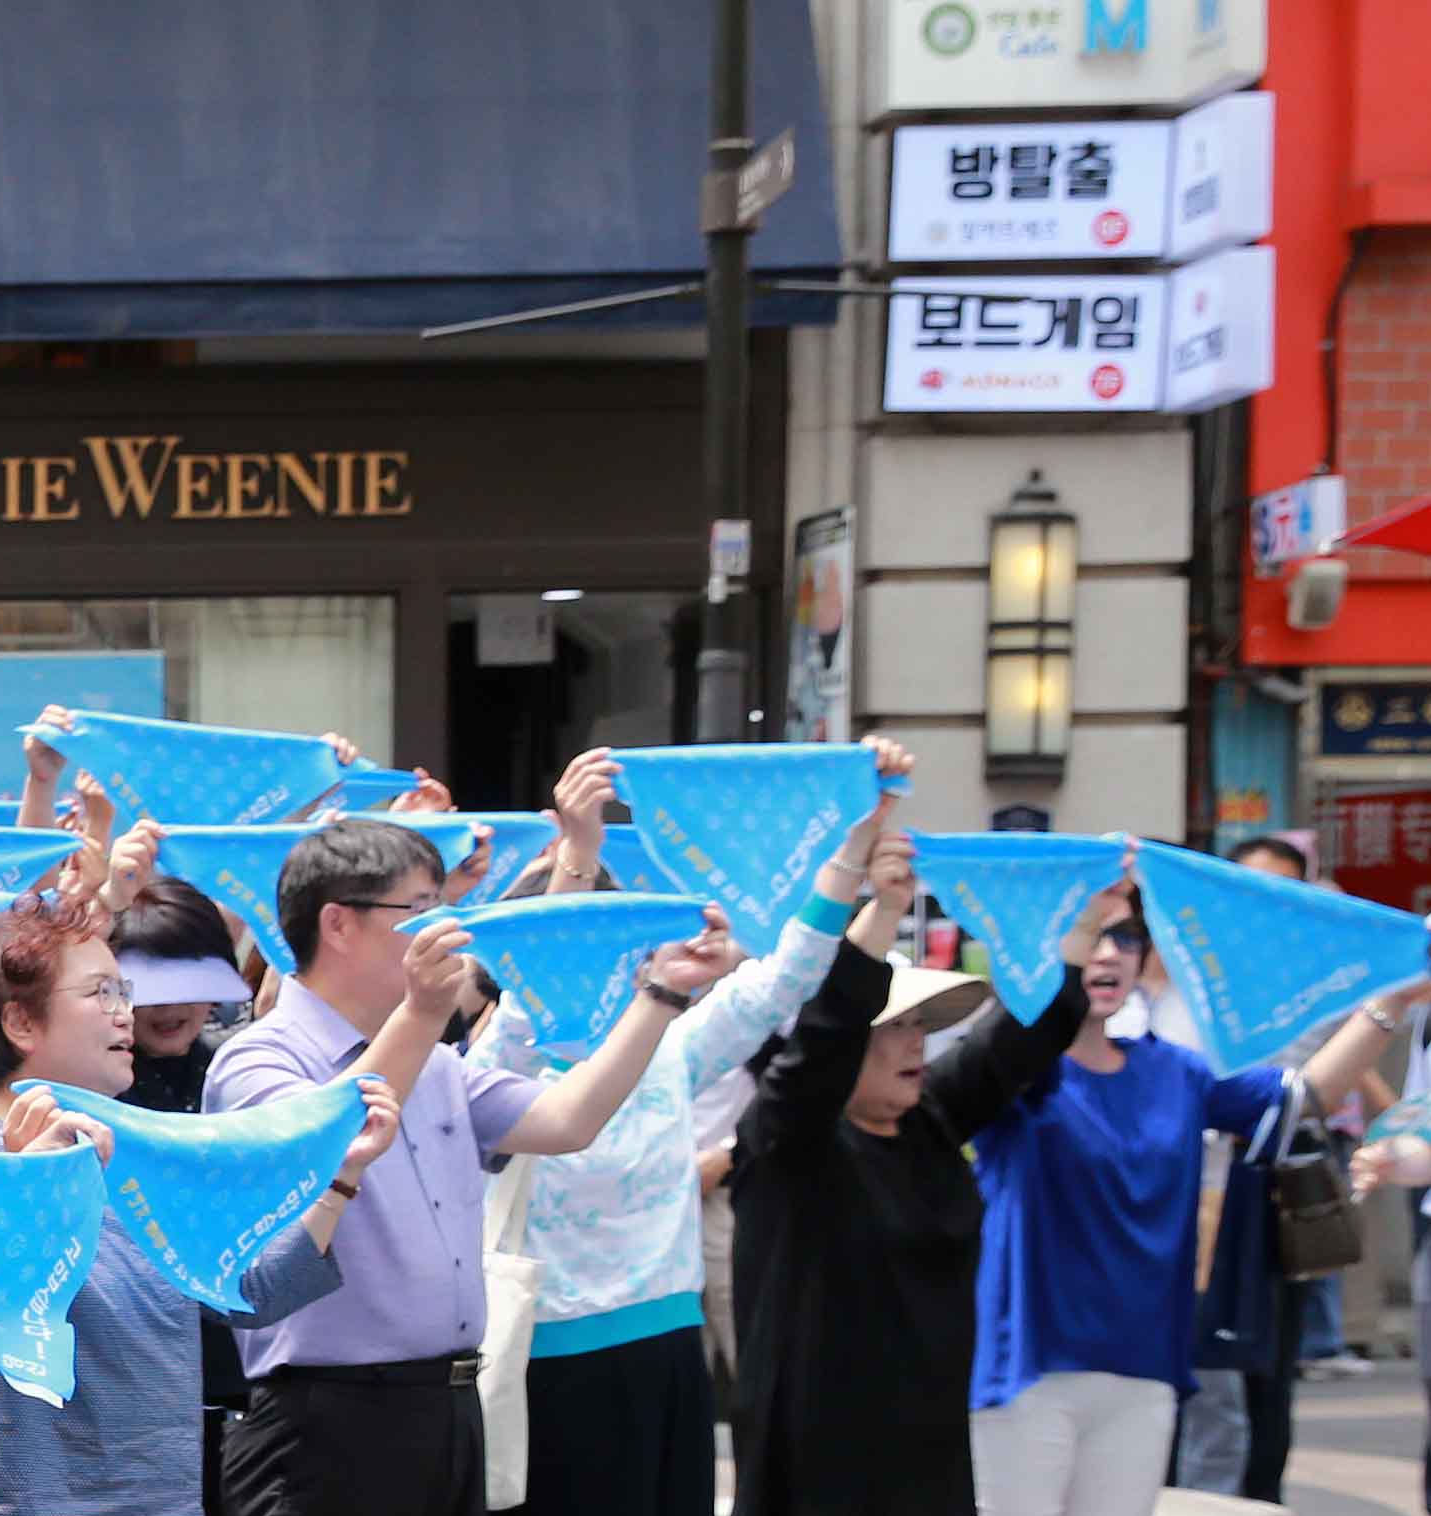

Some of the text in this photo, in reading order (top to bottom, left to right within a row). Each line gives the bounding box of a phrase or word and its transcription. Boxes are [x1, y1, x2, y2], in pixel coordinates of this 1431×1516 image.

[950, 142, 1113, 200] 방탈출
[916, 294, 1139, 350] 보드게임
[83, 435, 412, 519] WEENIE
[215, 1169, 318, 1293] 고맙습니다!
